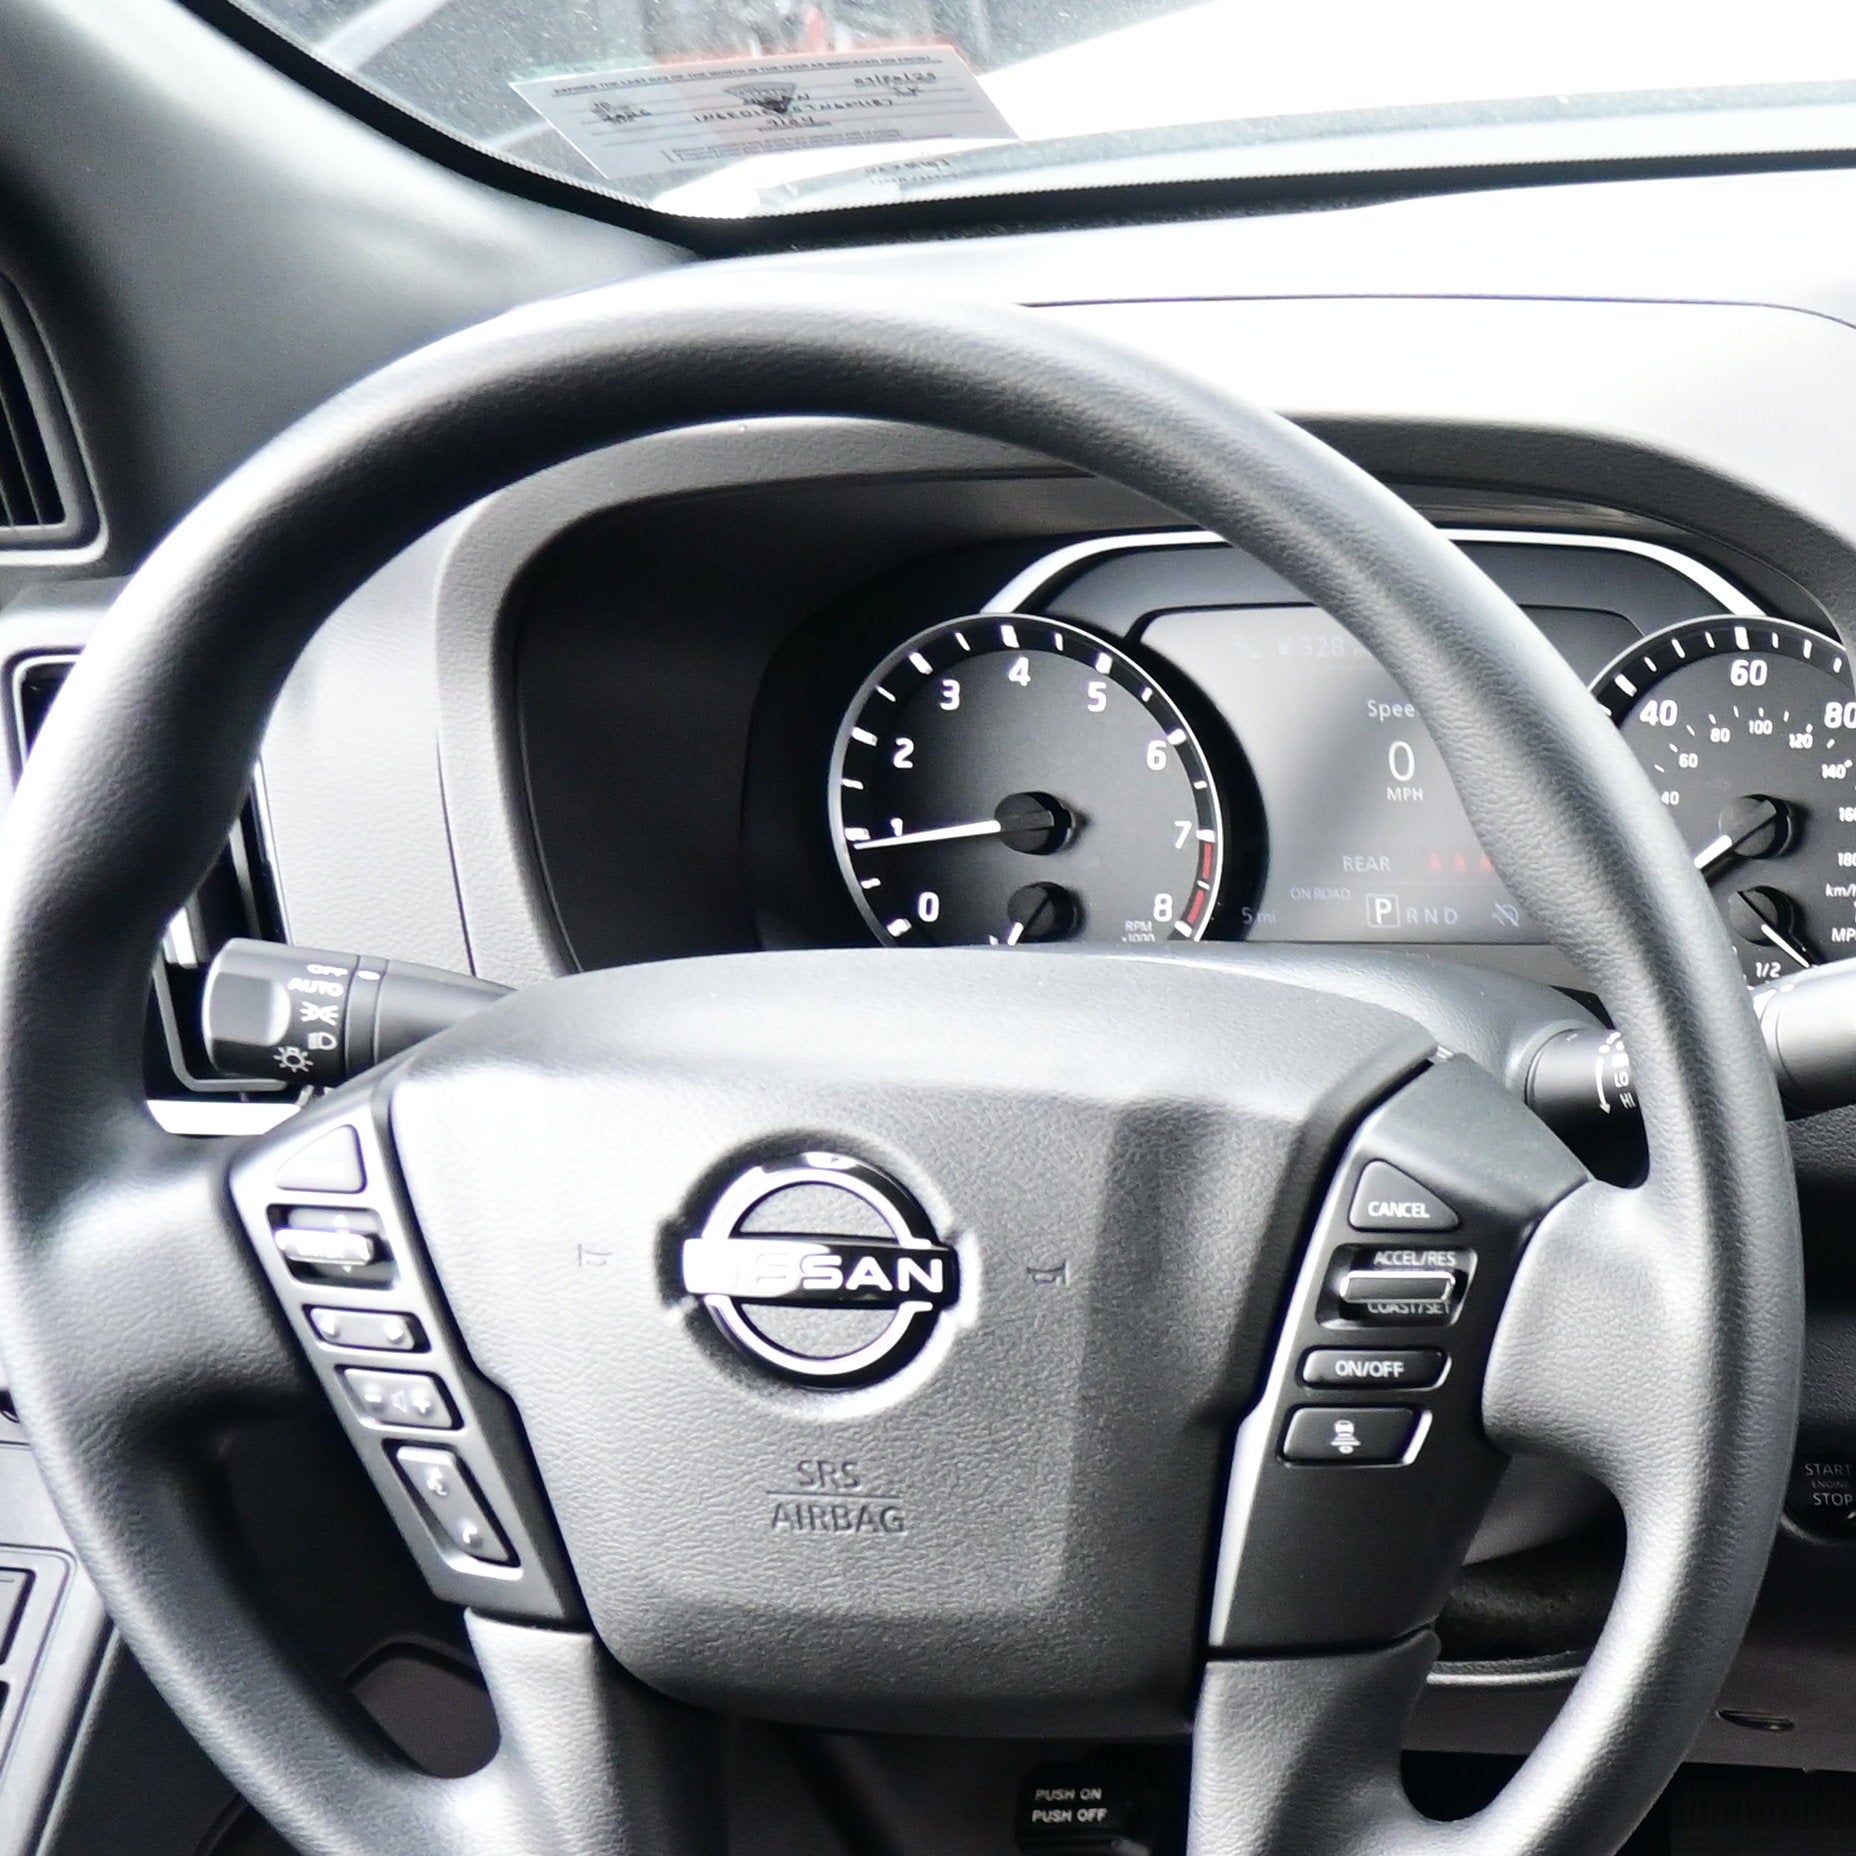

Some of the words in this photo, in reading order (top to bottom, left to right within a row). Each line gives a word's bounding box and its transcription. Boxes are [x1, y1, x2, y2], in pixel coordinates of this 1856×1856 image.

[1008, 657, 1031, 687] 4
[1730, 659, 1767, 686] 60
[940, 680, 961, 711] 3
[1087, 682, 1107, 712] 5
[1367, 701, 1417, 719] Spee
[1640, 700, 1677, 727] 40
[1710, 728, 1730, 743] 80
[1749, 721, 1773, 735] 100
[1789, 733, 1813, 749] 120
[892, 738, 914, 769] 2
[1146, 740, 1167, 771] 6
[1388, 740, 1416, 782] 0
[1679, 754, 1698, 768] 60
[1822, 765, 1846, 779] 140
[1386, 787, 1424, 802] MPH
[1661, 792, 1680, 805] 40
[1173, 821, 1192, 849] 7
[1342, 856, 1391, 874] REAR
[918, 892, 940, 922] 0
[1153, 894, 1173, 922] 8
[1374, 898, 1393, 924] P
[288, 978, 344, 997] AUTO
[1367, 1201, 1430, 1219] CANCEL
[1373, 1251, 1457, 1267] ACCEL/RES
[1335, 1361, 1405, 1378] ON/OFF
[797, 1459, 860, 1489] SRS
[1804, 1463, 1852, 1477] START
[1812, 1492, 1853, 1507] STOP
[771, 1503, 907, 1535] AIRBAG
[1032, 1808, 1073, 1823] PUSH
[1077, 1808, 1108, 1822] OFF
